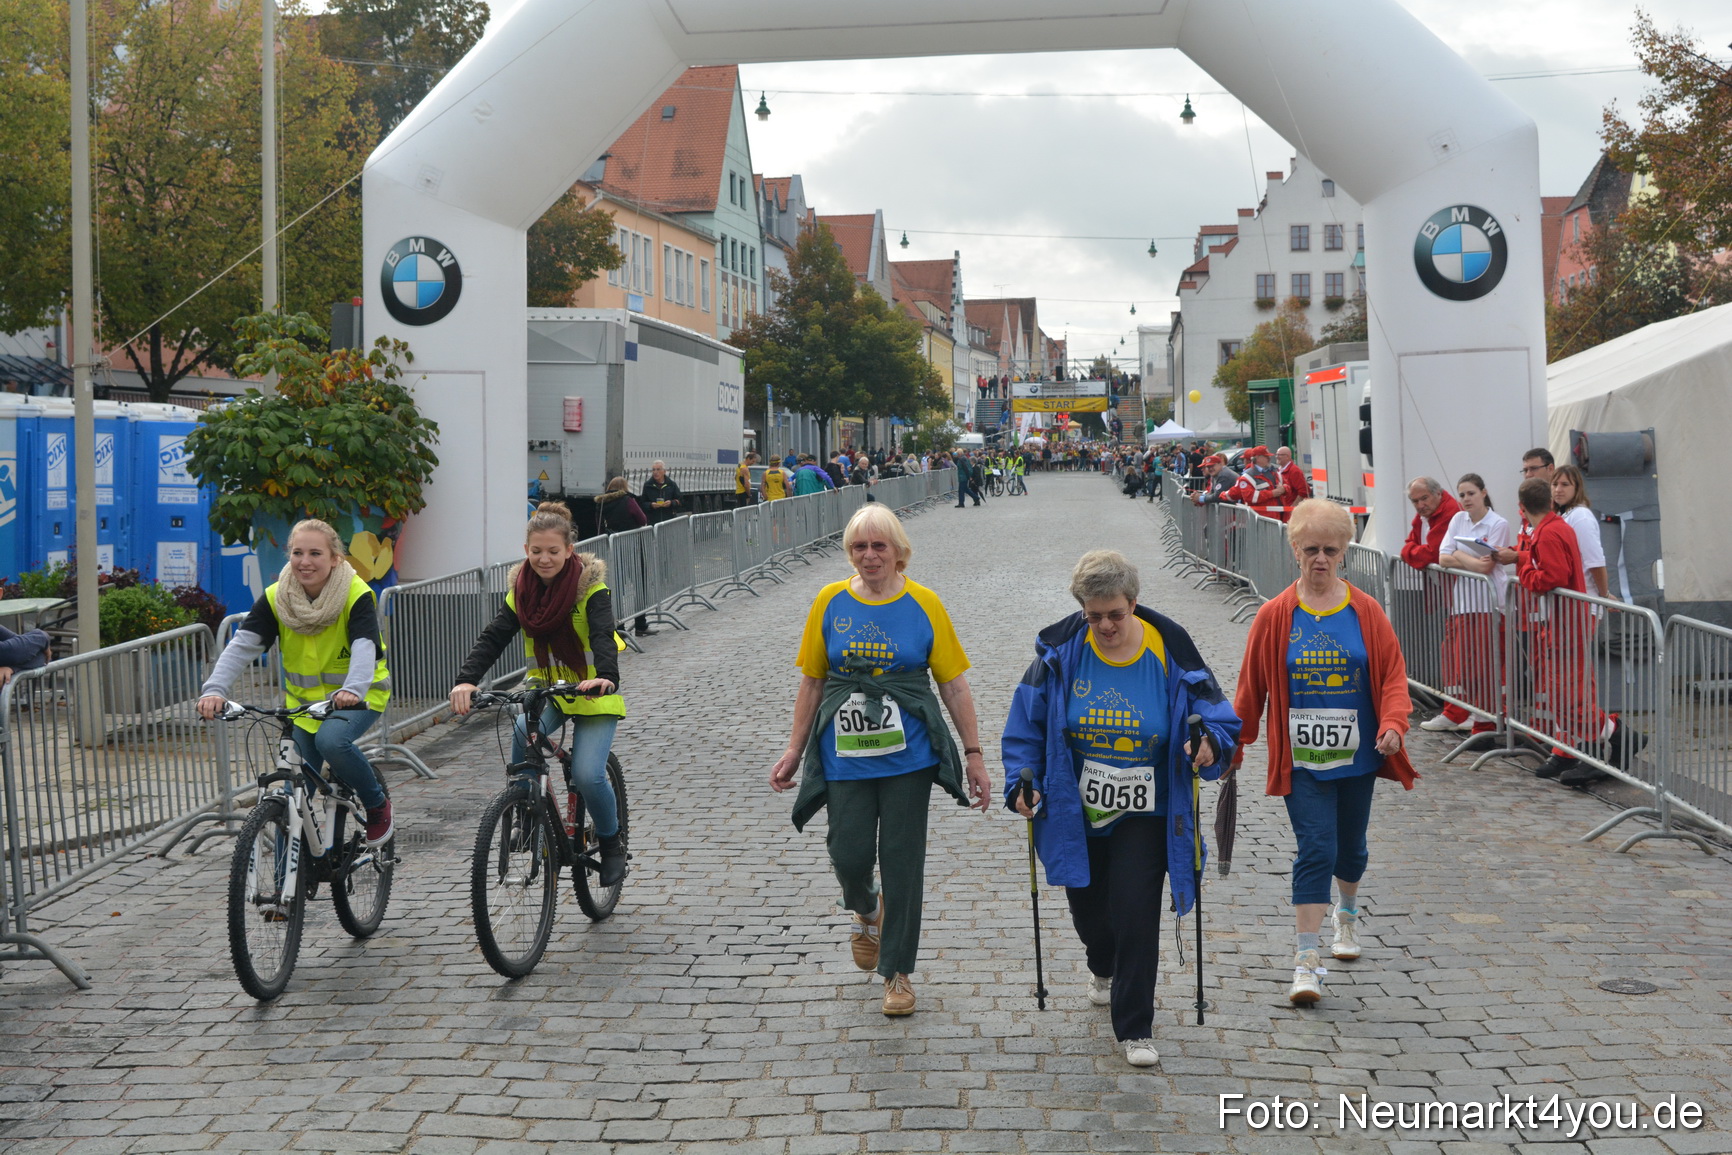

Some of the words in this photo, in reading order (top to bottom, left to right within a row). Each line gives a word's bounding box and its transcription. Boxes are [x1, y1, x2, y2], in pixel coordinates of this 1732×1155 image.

[1420, 206, 1500, 240] BMW
[386, 238, 455, 268] BMW
[1043, 400, 1076, 409] START
[1290, 713, 1314, 721] PARTL
[1315, 714, 1347, 722] Neumarkt
[857, 737, 880, 748] Irene
[1297, 723, 1352, 748] 5057
[1083, 766, 1107, 779] PARTL
[1107, 773, 1142, 782] Neumarkt
[1085, 778, 1148, 810] 5058
